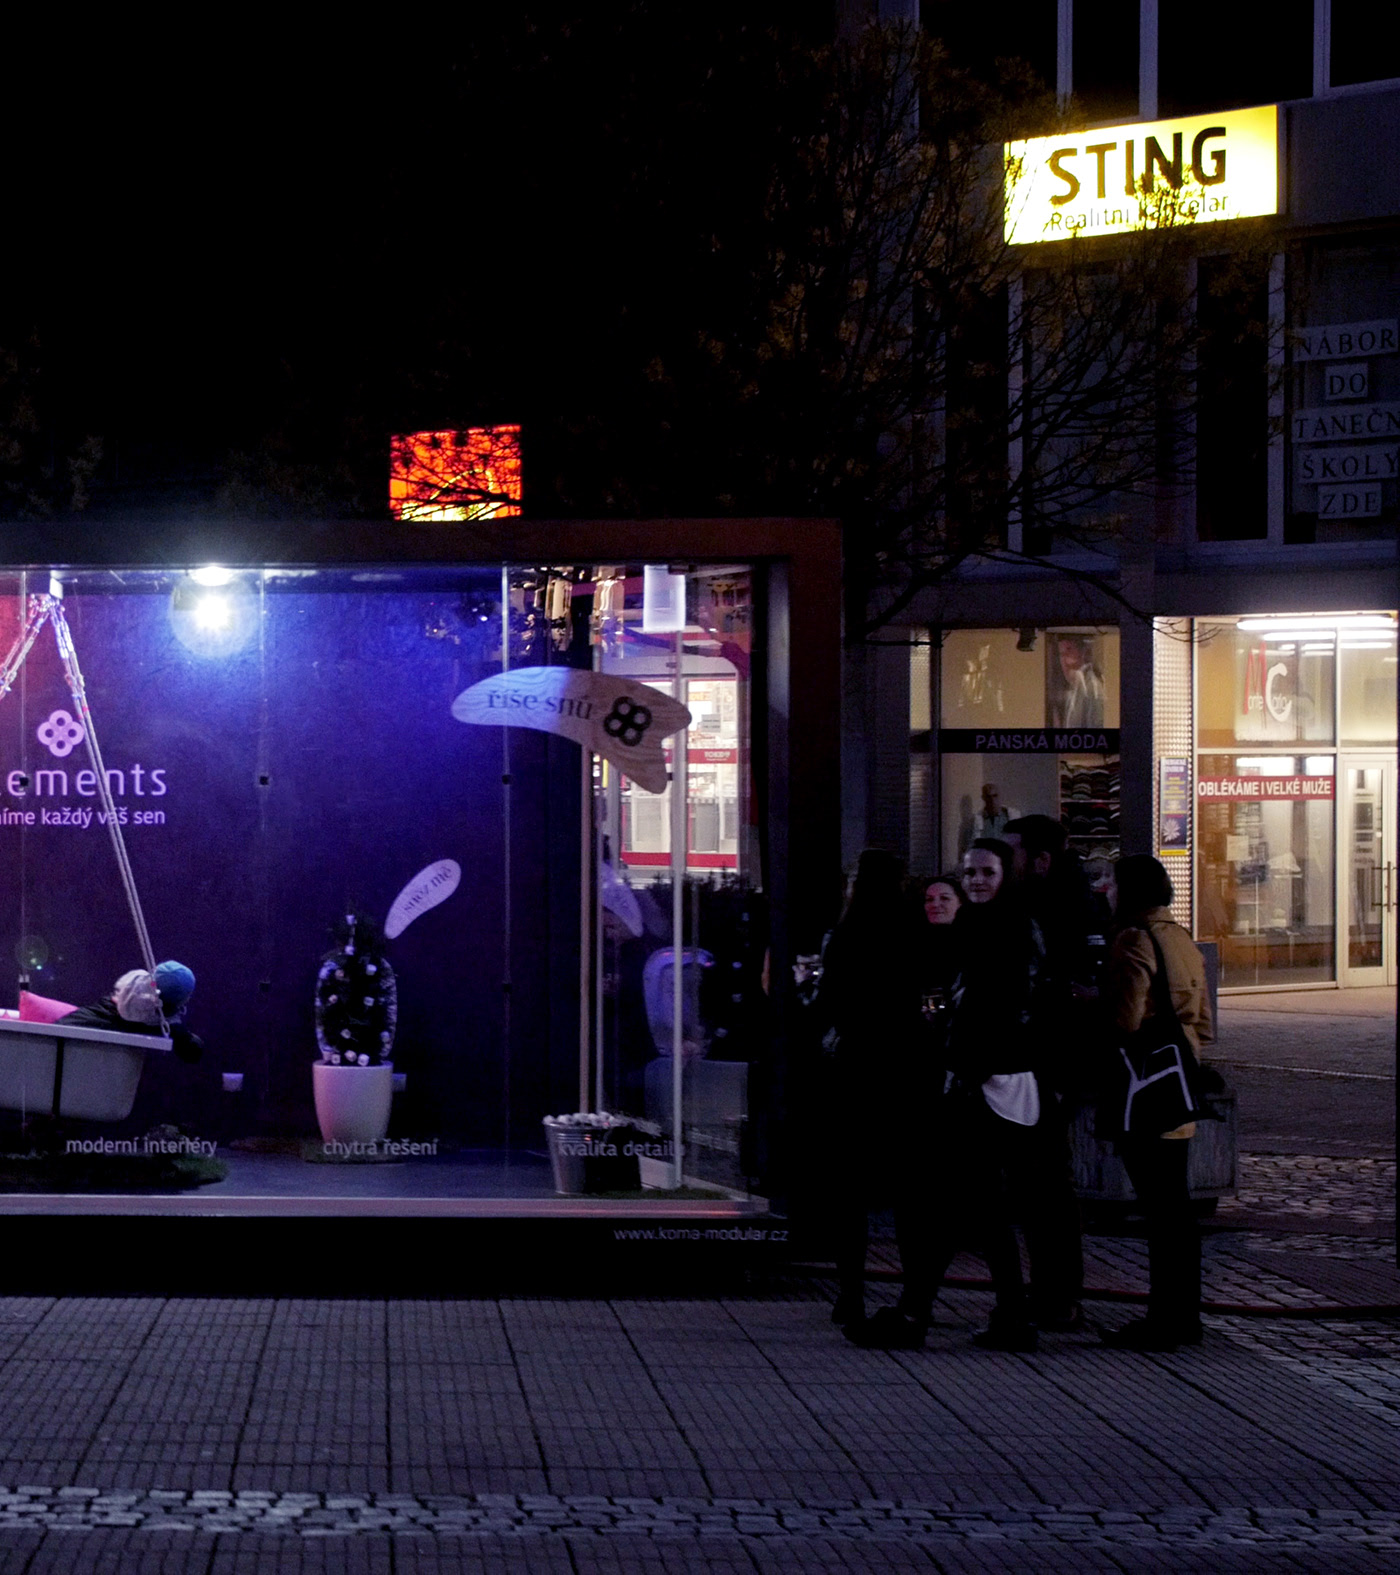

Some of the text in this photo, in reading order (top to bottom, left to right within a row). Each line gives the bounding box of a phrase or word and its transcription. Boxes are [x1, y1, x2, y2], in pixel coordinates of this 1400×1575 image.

[1048, 126, 1227, 206] STING
[1299, 328, 1395, 356] NÁBOR
[1329, 373, 1366, 396] DO
[1303, 453, 1400, 479] ŠKOLY
[1322, 492, 1377, 515] ZDE
[975, 730, 1109, 749] PÁNSKÁ MÓDA
[1198, 778, 1260, 796] OBLÉKÁME
[1266, 778, 1300, 795] VELKÉ
[1302, 778, 1331, 795] MUŽE
[40, 807, 93, 829] každý
[133, 810, 166, 825] sen
[66, 1136, 139, 1154] moderní
[323, 1138, 439, 1159] chytrá řešení
[559, 1139, 618, 1157] kvalita
[612, 1225, 790, 1241] www.koma-modular.cz
